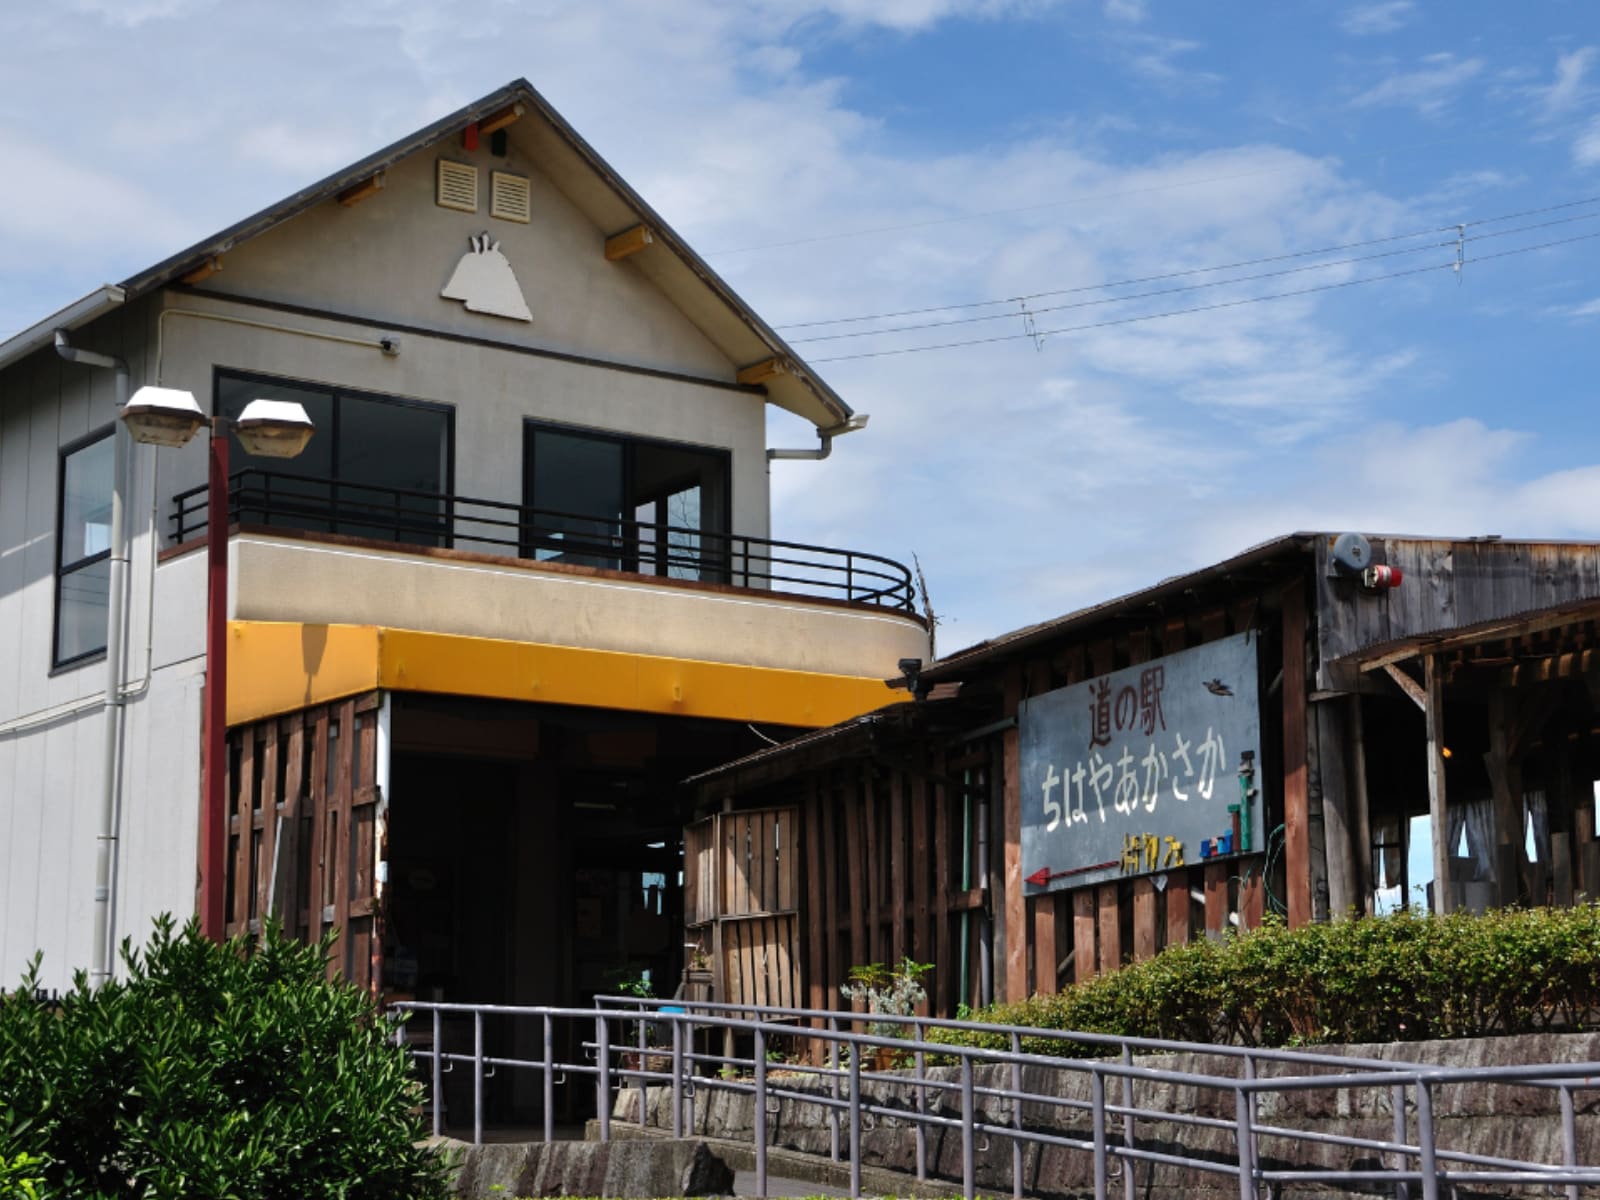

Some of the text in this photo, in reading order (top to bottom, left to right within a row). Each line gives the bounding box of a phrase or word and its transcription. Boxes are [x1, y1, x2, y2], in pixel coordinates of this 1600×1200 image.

[1089, 665, 1166, 750] 道の駅
[1042, 726, 1226, 832] ちはやあかさか
